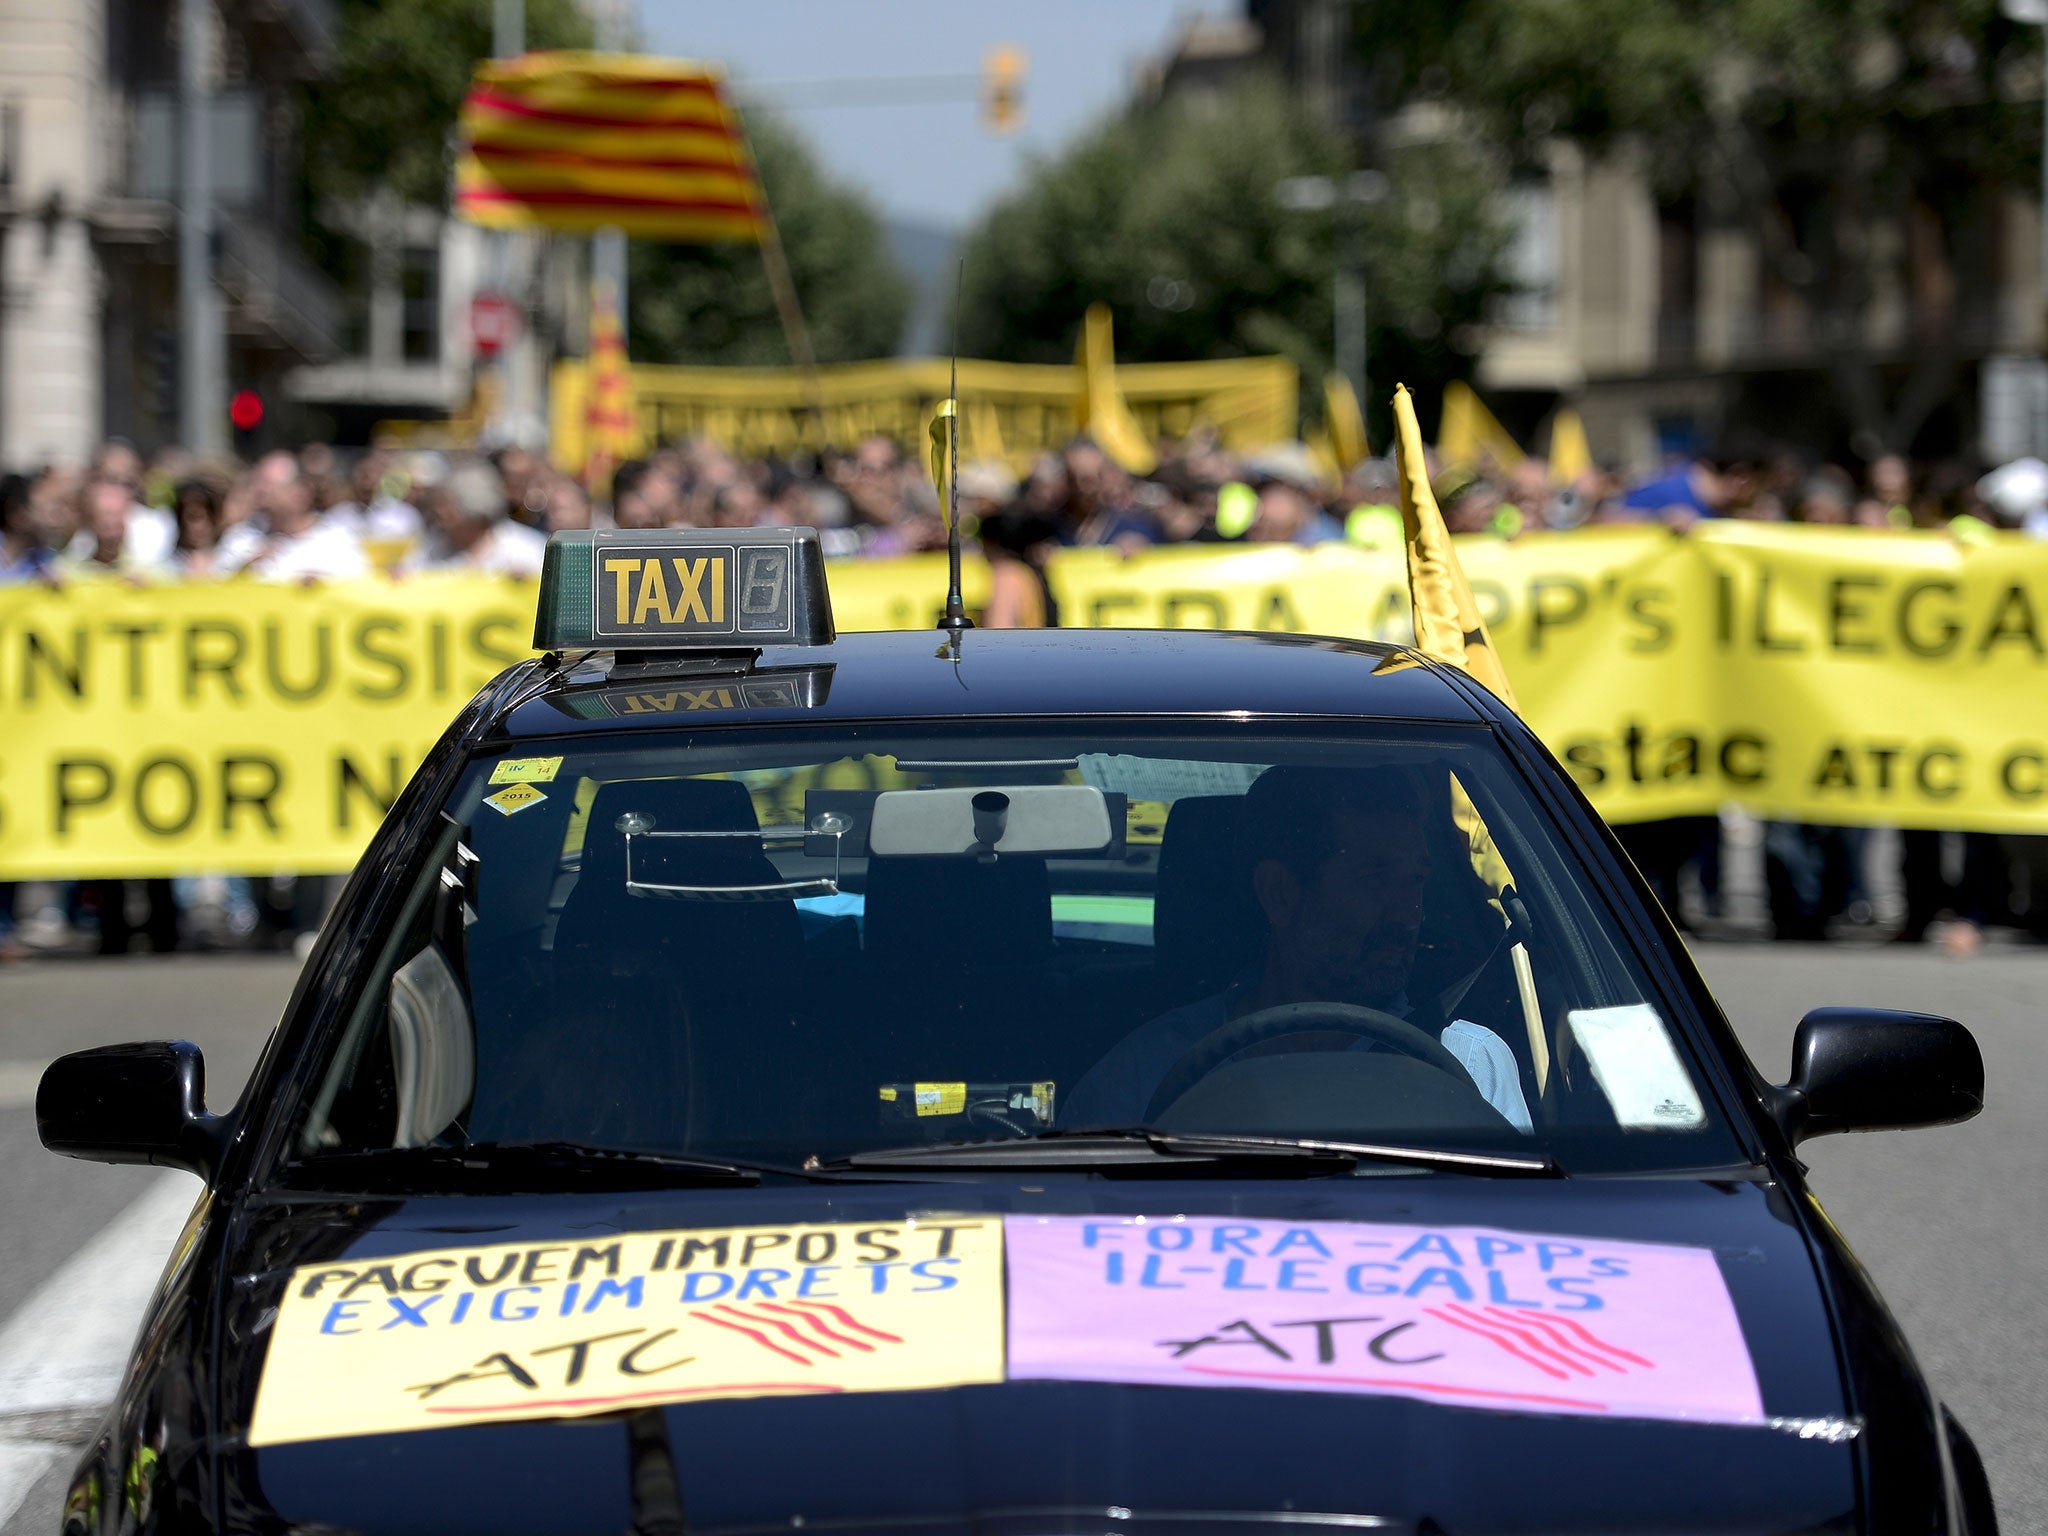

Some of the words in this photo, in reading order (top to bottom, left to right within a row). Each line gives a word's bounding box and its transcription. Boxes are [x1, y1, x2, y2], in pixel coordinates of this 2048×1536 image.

[605, 557, 725, 625] TAXI
[1715, 572, 2047, 660] ILEGA
[55, 755, 282, 837] POR
[1815, 743, 1960, 798] ATC
[300, 1243, 622, 1299] PAGUEM
[650, 1224, 984, 1272] IMPOST
[320, 1276, 645, 1335] EXIGIM
[680, 1257, 961, 1303] DRETS
[403, 1327, 696, 1399] ATC
[1154, 1316, 1445, 1365] ATC
